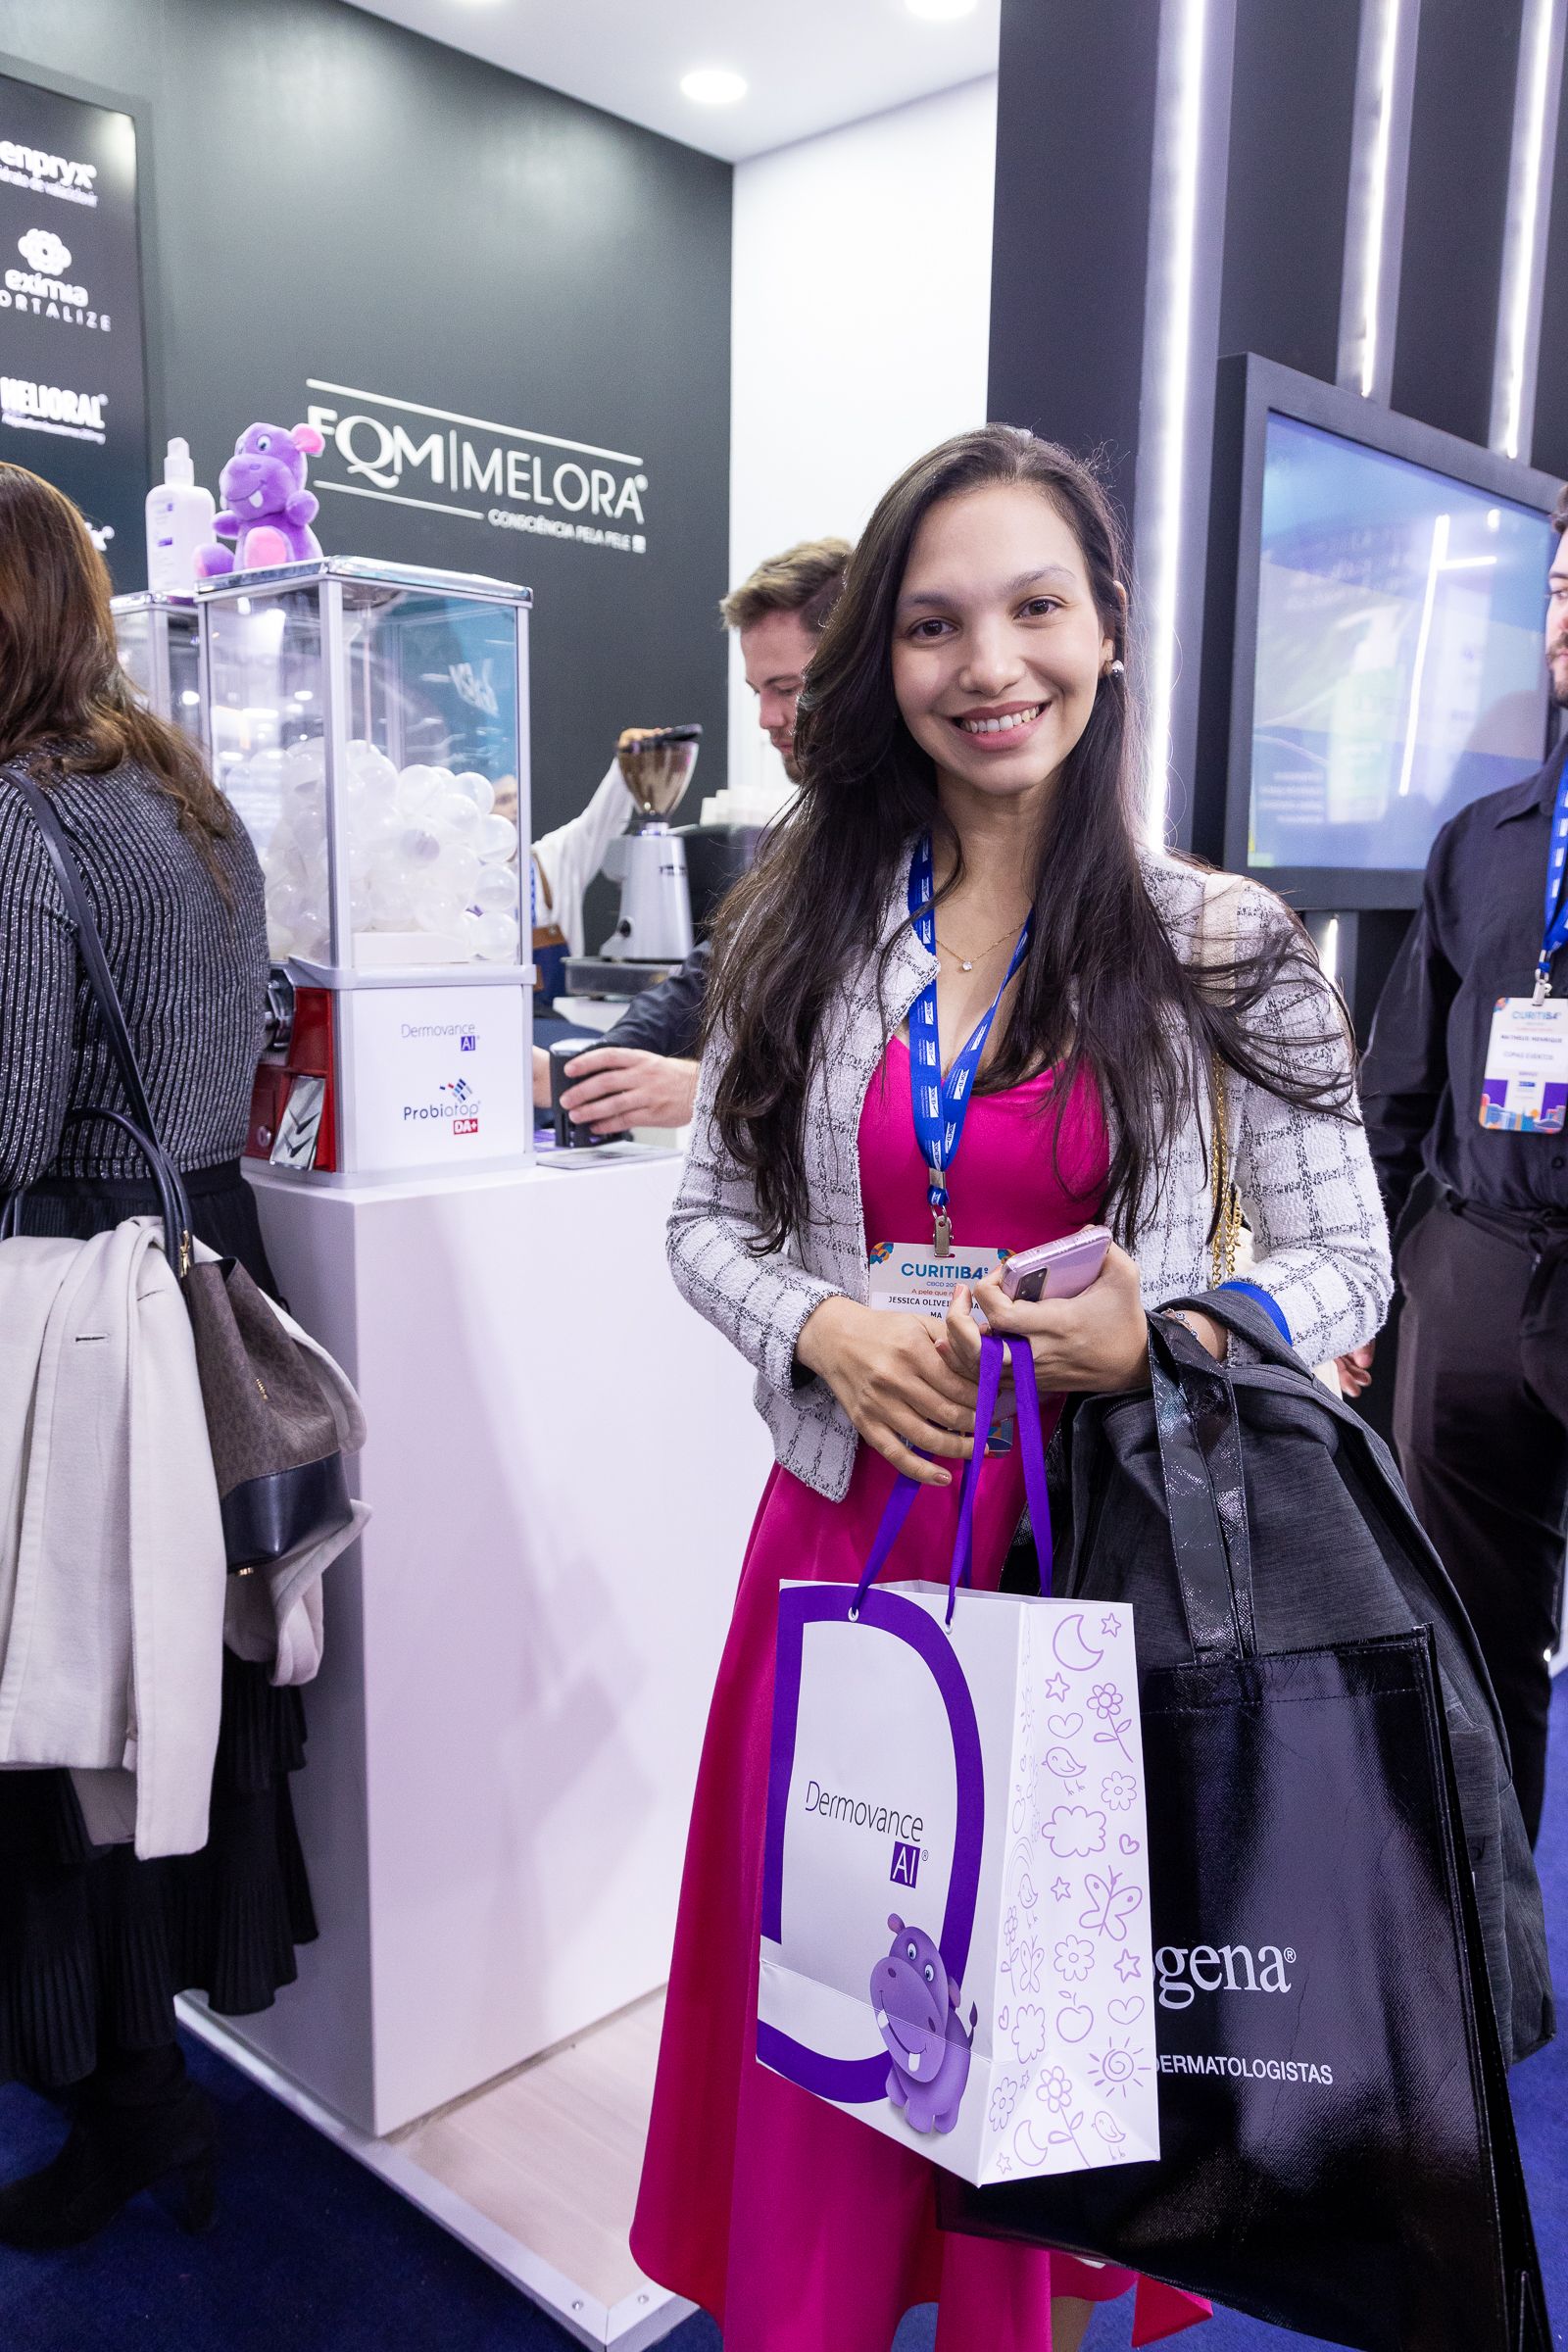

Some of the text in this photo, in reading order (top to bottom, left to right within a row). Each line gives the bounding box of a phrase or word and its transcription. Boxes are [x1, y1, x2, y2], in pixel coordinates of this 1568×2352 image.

[401, 1023, 475, 1038] Dermovance
[888, 1296, 950, 1307] JESSICA OLIVEI
[917, 1289, 934, 1298] pele
[805, 1780, 924, 1842] Dermovance
[1153, 1944, 1297, 2009] gena®
[1155, 2054, 1334, 2084] ERMATOLOGISTAS
